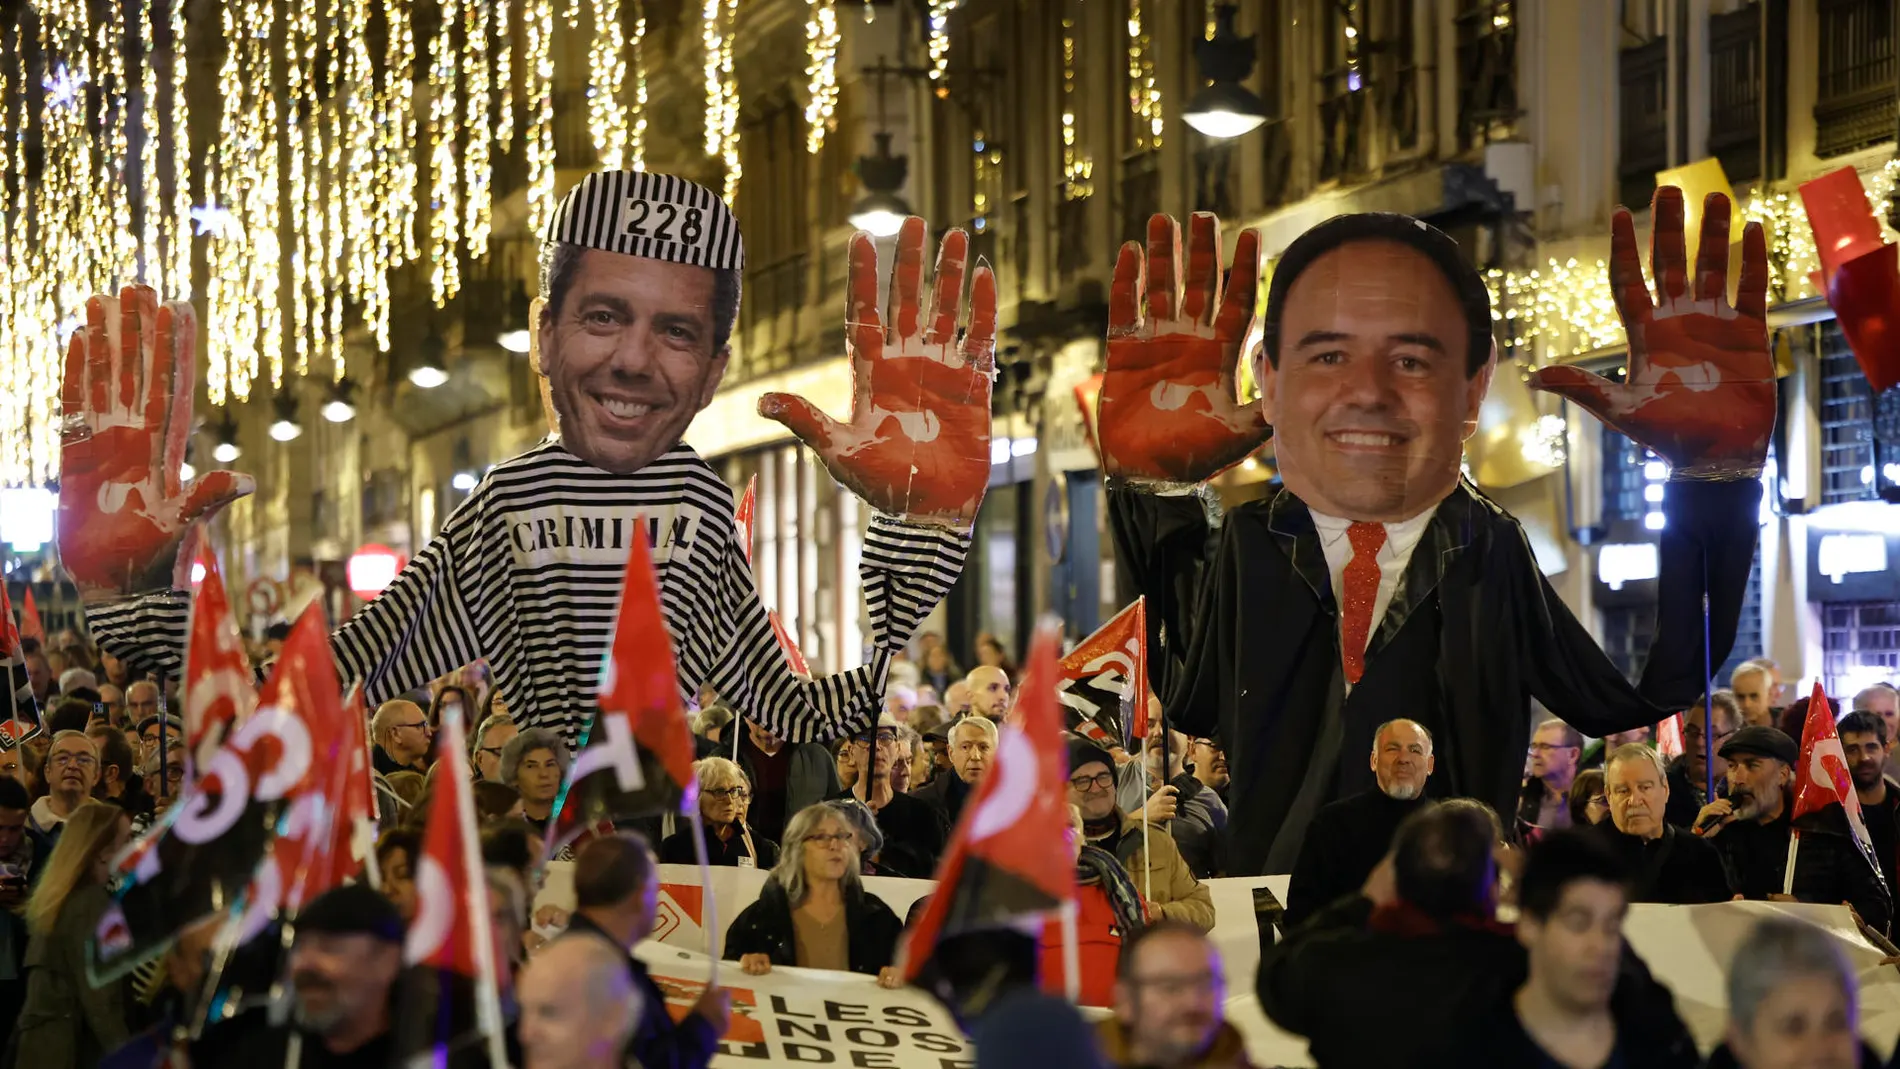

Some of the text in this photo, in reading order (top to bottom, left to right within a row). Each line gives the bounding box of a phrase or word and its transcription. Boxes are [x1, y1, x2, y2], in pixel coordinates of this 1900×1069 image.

[627, 200, 702, 245] 228
[770, 995, 932, 1027] LES
[776, 1018, 976, 1054] NOS
